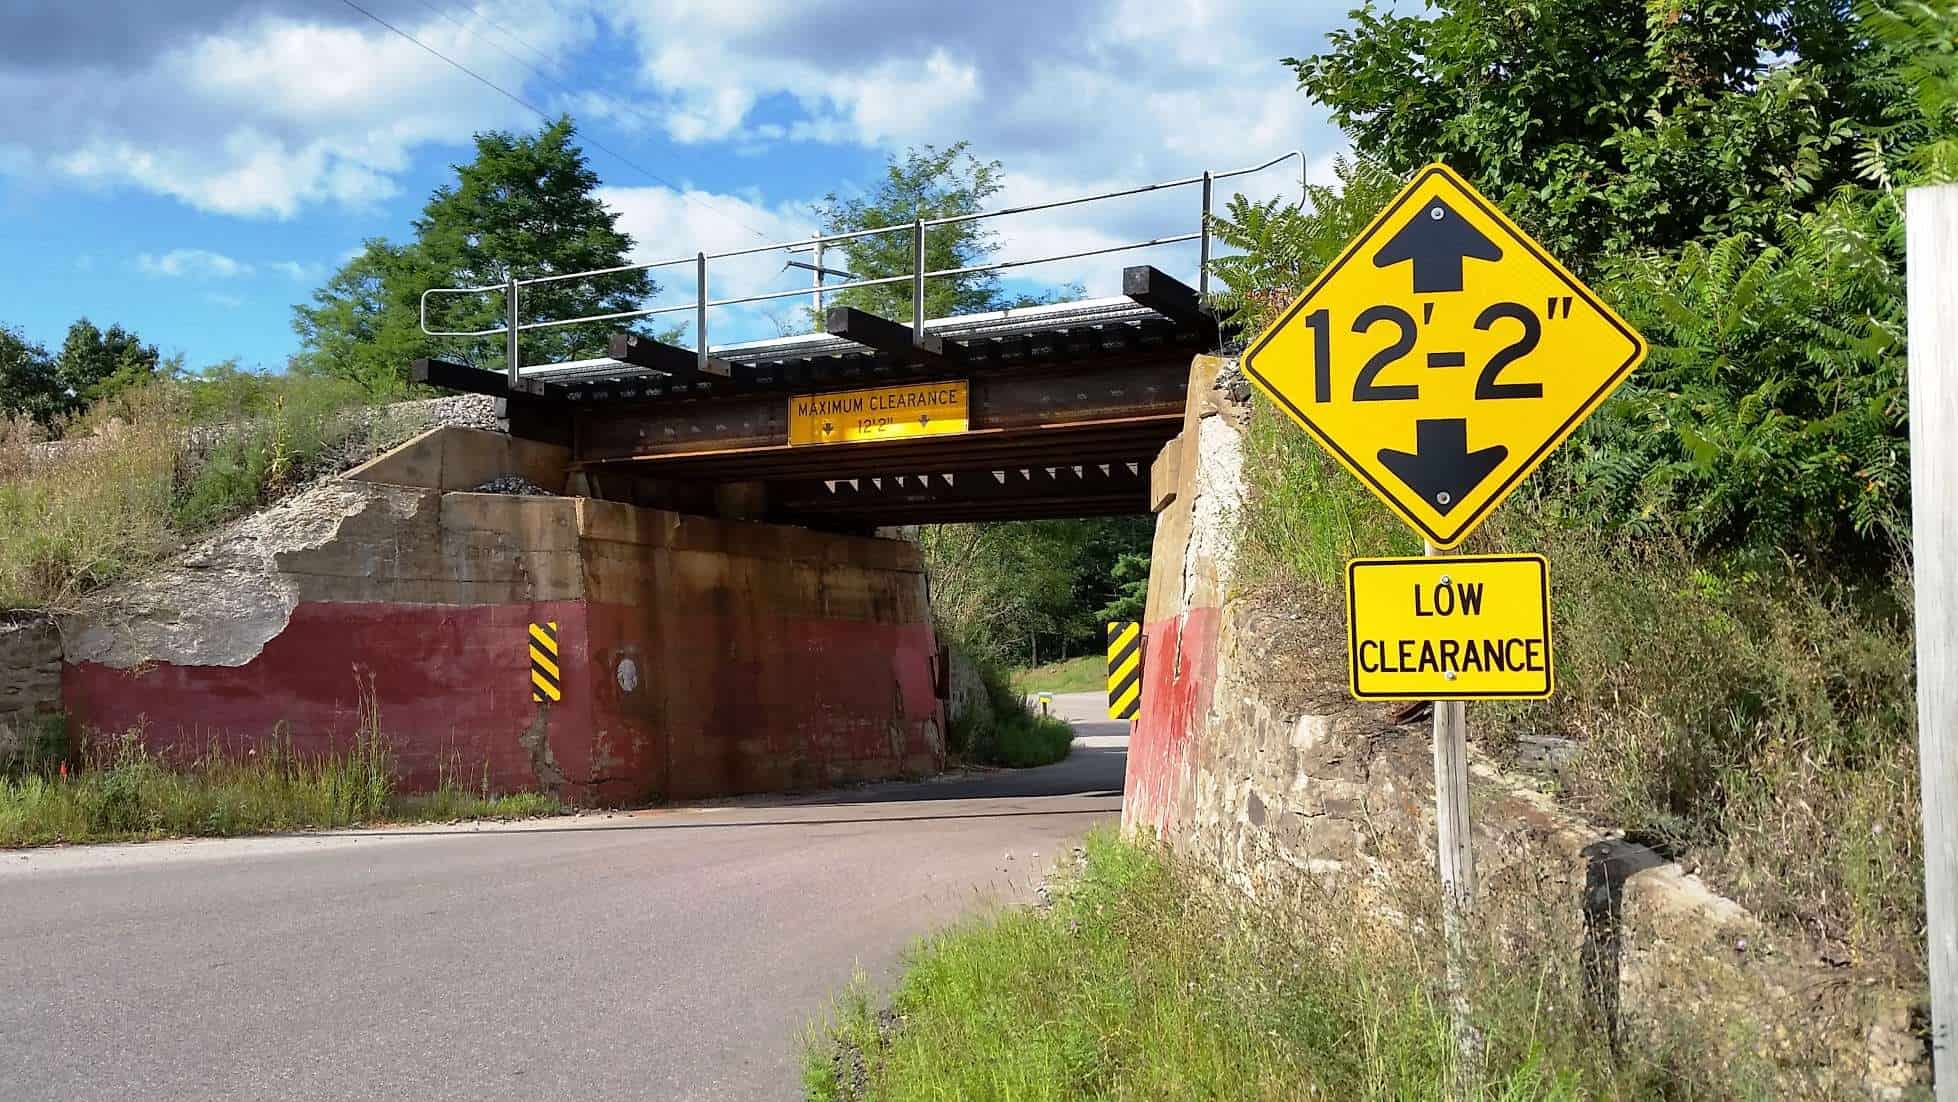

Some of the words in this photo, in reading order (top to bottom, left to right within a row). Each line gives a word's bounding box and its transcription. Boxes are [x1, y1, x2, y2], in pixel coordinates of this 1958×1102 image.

[1305, 296, 1573, 403] 12'-2"
[798, 398, 863, 416] MAXIMUM
[869, 390, 957, 411] CLEARANCE
[1415, 583, 1484, 617] LOW
[1360, 638, 1545, 673] CLEARANCE
